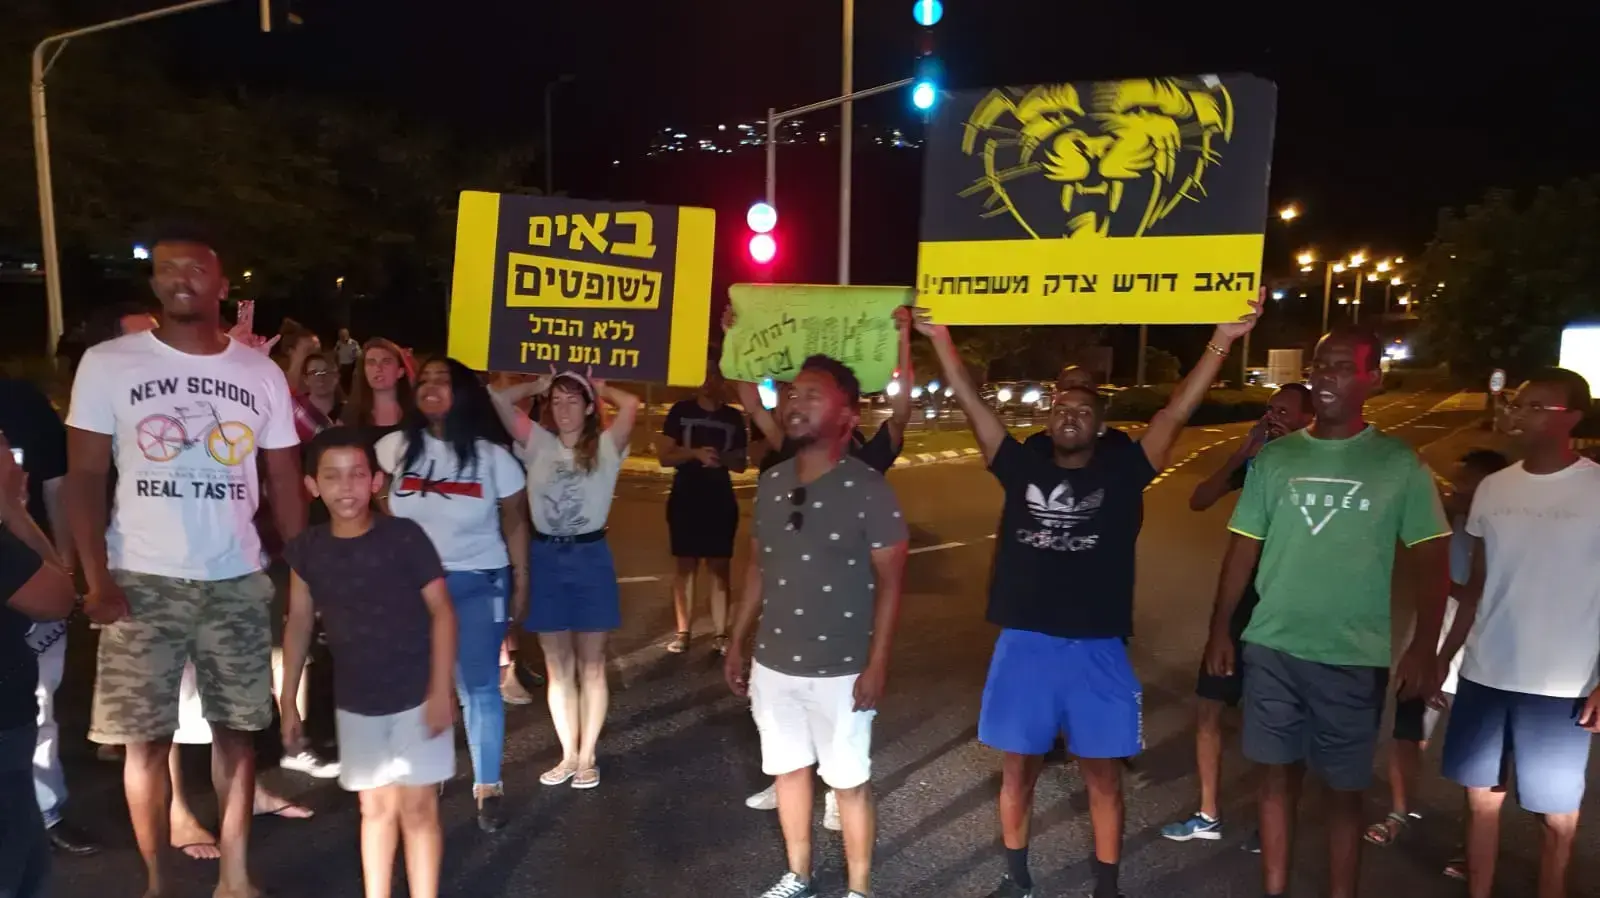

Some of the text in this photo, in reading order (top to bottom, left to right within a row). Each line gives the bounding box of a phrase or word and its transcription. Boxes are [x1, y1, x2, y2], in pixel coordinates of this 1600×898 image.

[528, 210, 656, 259] באים
[514, 263, 656, 303] לשופטים
[1042, 274, 1098, 297] צדק
[1112, 273, 1178, 293] דורש
[1193, 272, 1255, 292] האב
[529, 313, 635, 341] ללא הבדל
[520, 341, 640, 368] דת גזע ומין
[129, 376, 260, 416] NEW SCHOOL
[136, 480, 246, 500] REAL TASTE
[1015, 528, 1100, 552] adidas
